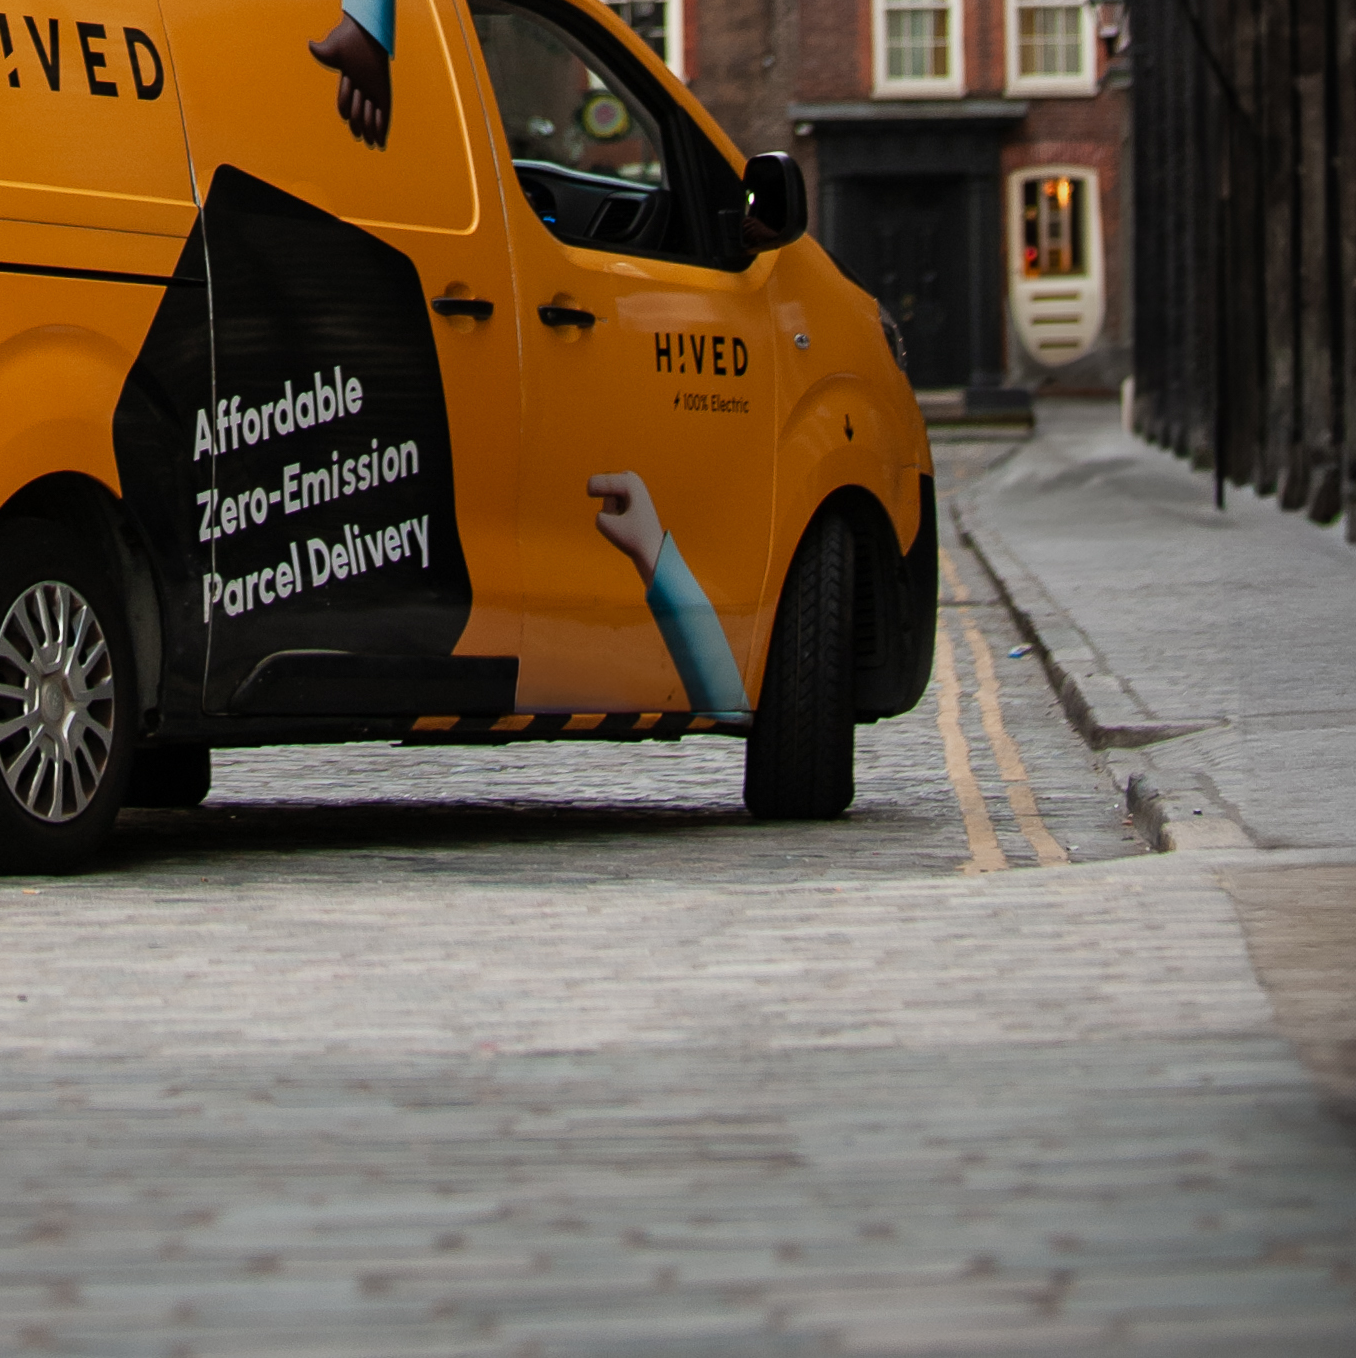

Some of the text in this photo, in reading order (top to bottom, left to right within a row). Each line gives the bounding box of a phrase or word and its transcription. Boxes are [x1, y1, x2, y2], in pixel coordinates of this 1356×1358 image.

[193, 365, 363, 461] Affordable
[683, 392, 750, 414] 100% Electric
[196, 438, 420, 542] Zero-Emission
[202, 514, 430, 624] Parcel Delivery
